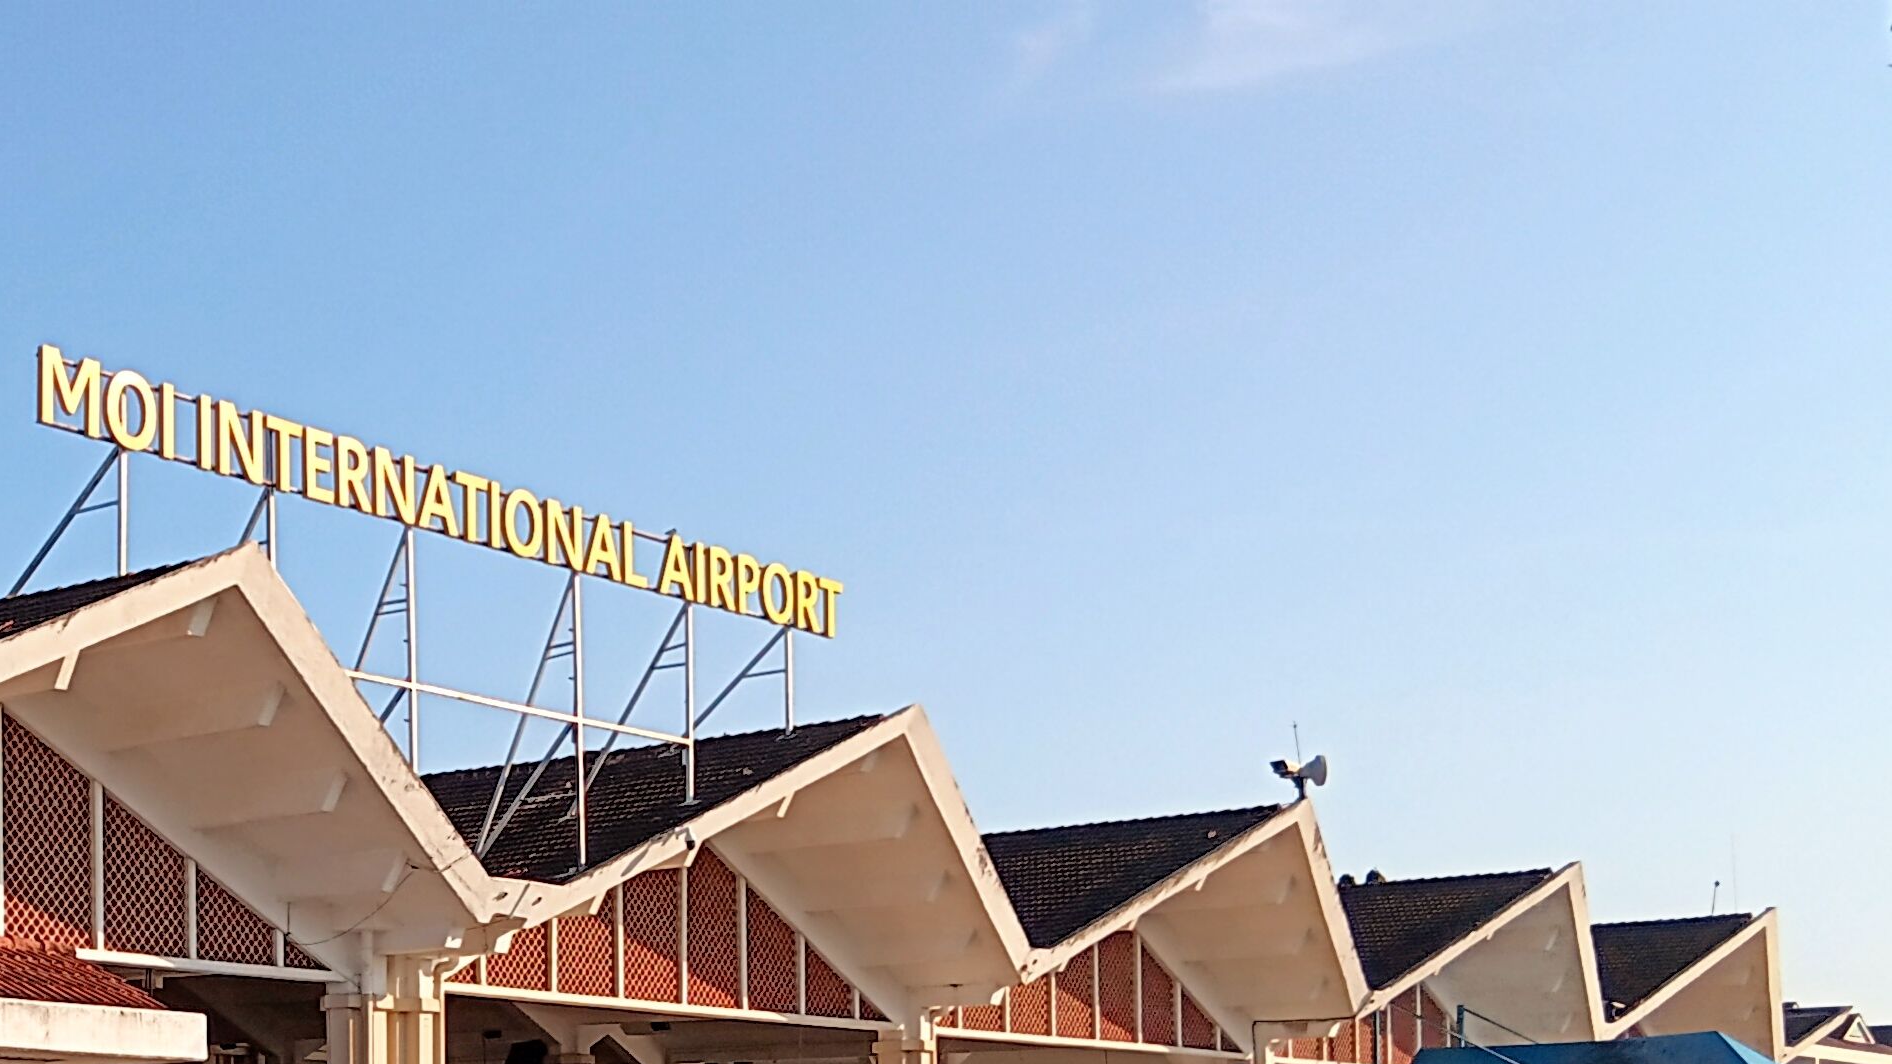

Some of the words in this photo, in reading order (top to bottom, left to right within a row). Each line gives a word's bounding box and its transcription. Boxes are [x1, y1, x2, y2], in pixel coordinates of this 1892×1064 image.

[37, 343, 175, 460] MOI
[196, 393, 648, 588] INTERNATIONAL
[658, 533, 844, 639] AIRPORT
